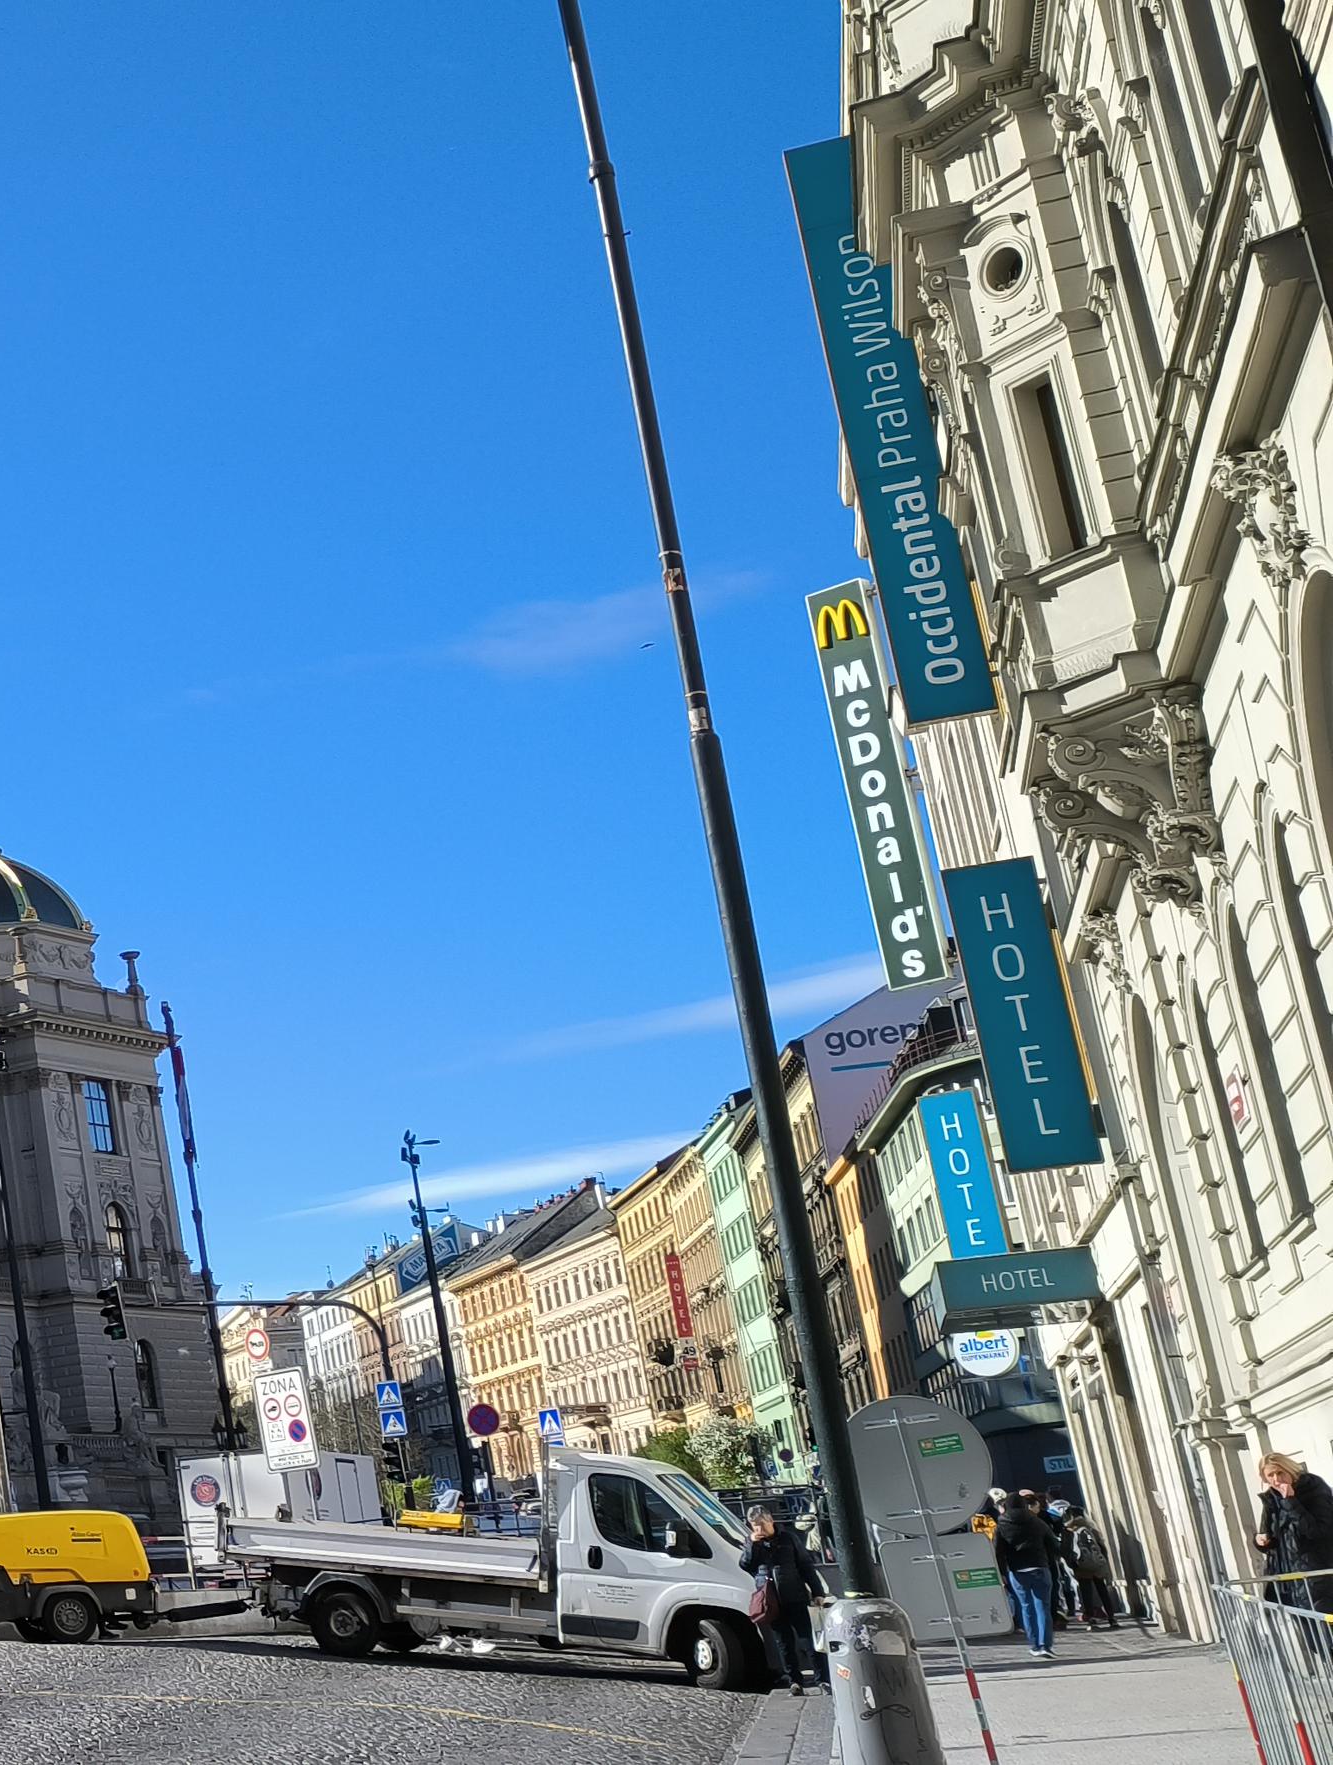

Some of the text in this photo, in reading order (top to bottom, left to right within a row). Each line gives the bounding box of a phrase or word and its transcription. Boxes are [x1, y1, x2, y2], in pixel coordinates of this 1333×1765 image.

[837, 234, 965, 686] Occidental Praha Wilson
[833, 658, 926, 979] McDonald's
[824, 1022, 919, 1057] goren
[979, 892, 1060, 1136] HOTEL
[940, 1112, 986, 1246] HOTE
[959, 1336, 1009, 1353] albert
[981, 1267, 1055, 1294] HOTEL
